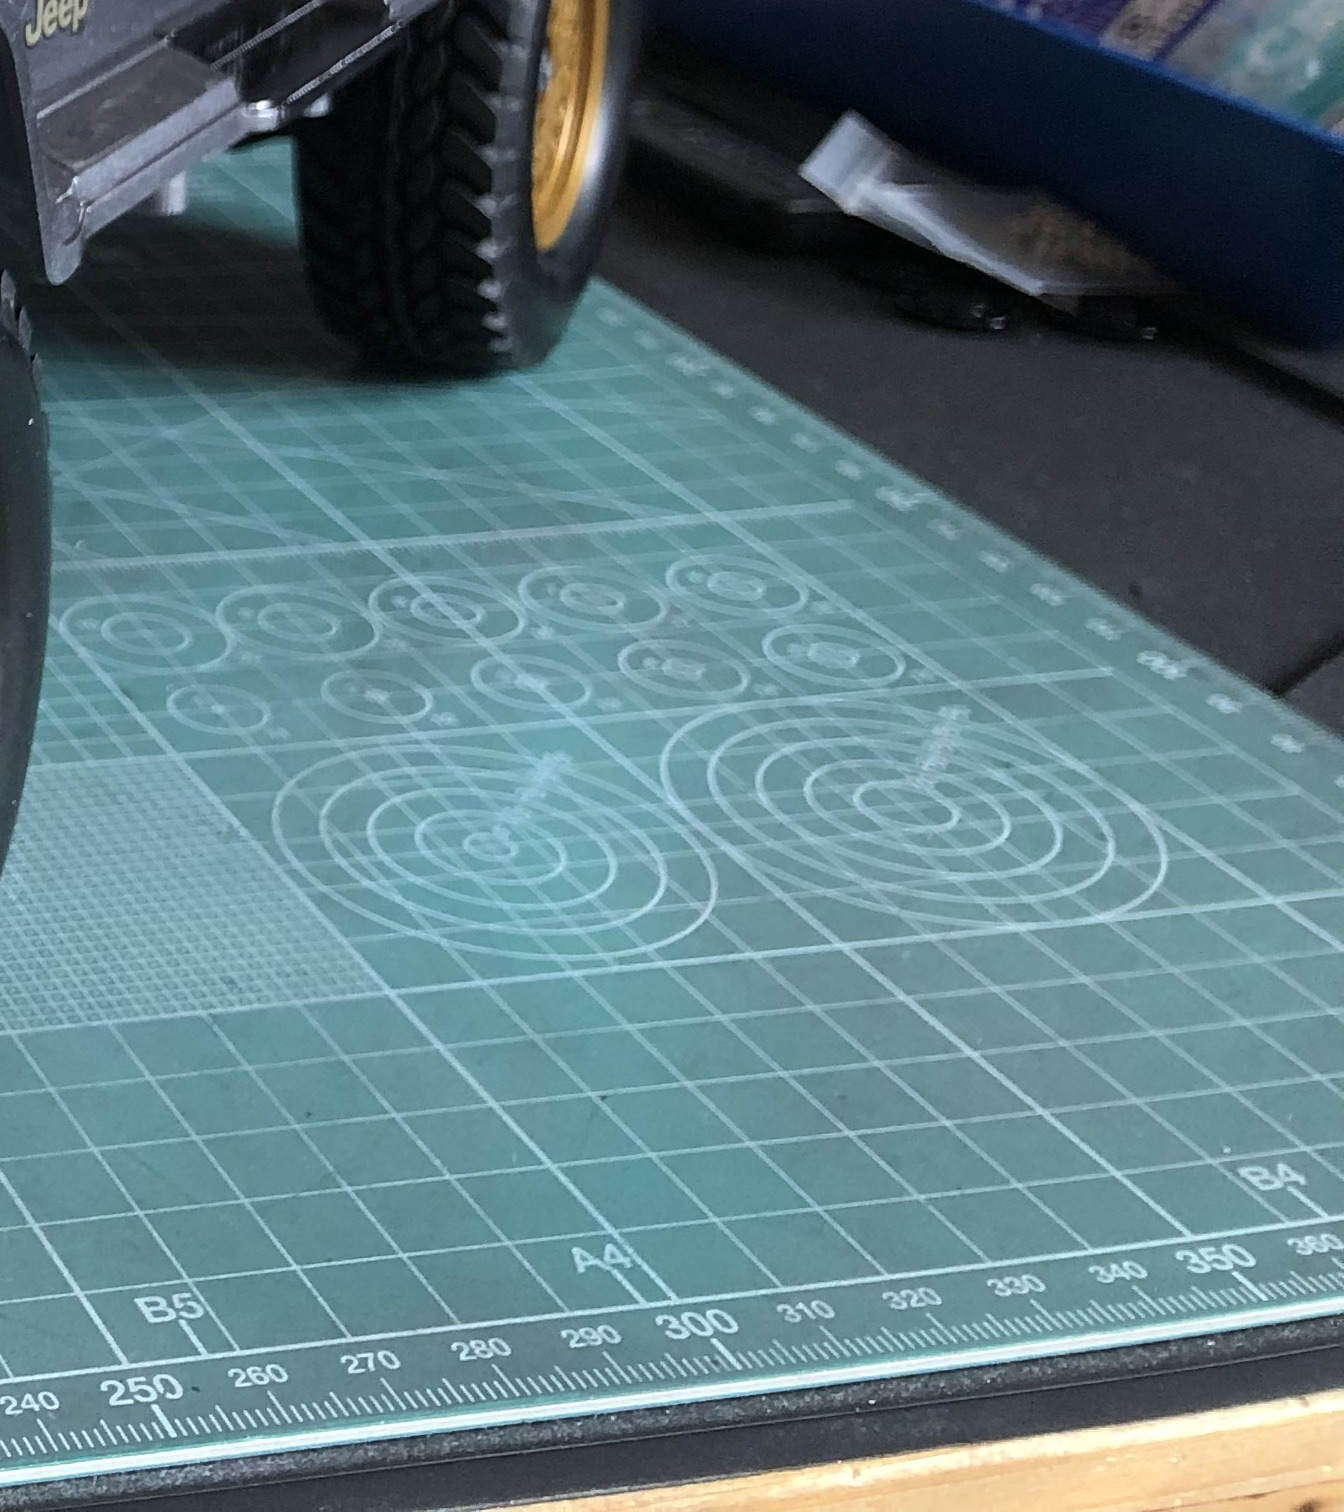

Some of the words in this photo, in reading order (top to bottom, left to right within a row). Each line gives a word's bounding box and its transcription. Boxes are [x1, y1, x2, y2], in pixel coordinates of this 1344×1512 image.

[1237, 1161, 1307, 1191] B4
[571, 1243, 633, 1274] A4
[134, 1292, 205, 1324] B5
[0, 1391, 60, 1416] 240
[100, 1373, 184, 1406] 250
[227, 1363, 289, 1388] 260
[340, 1350, 401, 1375] 270
[451, 1337, 512, 1361] 280
[561, 1325, 622, 1349] 290
[655, 1308, 739, 1339] 300
[776, 1299, 836, 1323] 310
[882, 1287, 943, 1310] 320
[986, 1274, 1046, 1297] 330
[1087, 1260, 1148, 1284] 340
[1175, 1243, 1257, 1274] 350
